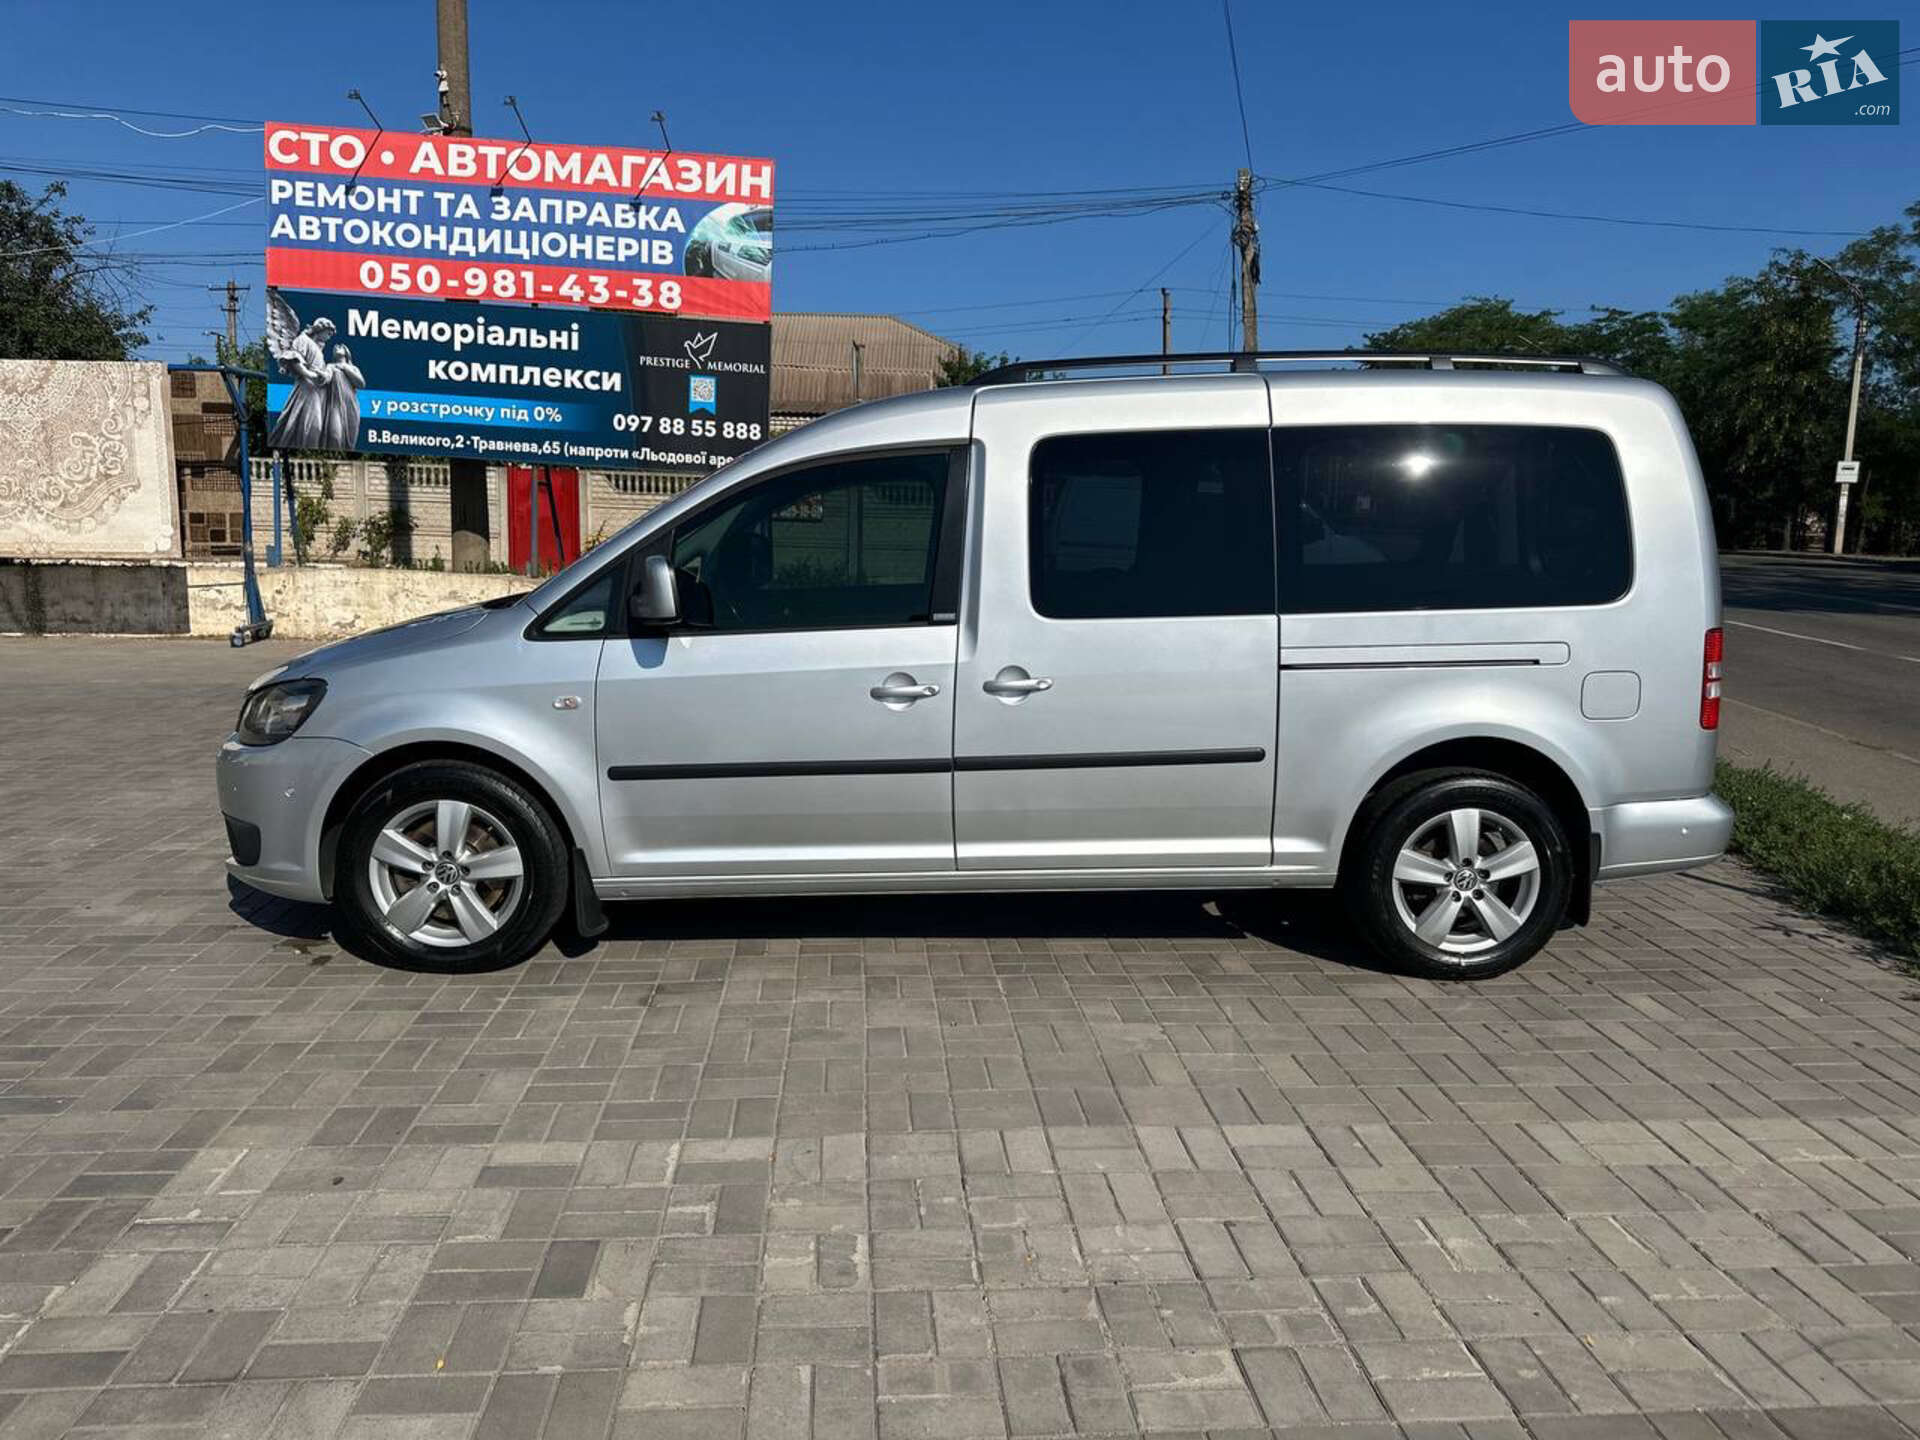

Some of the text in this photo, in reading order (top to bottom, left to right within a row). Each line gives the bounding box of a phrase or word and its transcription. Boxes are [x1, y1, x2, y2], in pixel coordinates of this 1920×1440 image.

[268, 130, 772, 198] СТО АВТОМАГАЗИН
[270, 179, 686, 233] РЕМОНТ ТА ЗАПРАВКА
[270, 214, 674, 265] АВТОКОНДИЦІОНЕРІВ
[359, 260, 682, 310] 050-981-43-38
[348, 309, 580, 351] Меморіальні
[428, 359, 622, 392] комплекси
[640, 356, 766, 374] PRESTIGE MEMORIAL
[371, 400, 562, 422] у розстрочку під 0%
[613, 413, 762, 440] 097 88 55 888
[564, 442, 629, 461] (напроти
[632, 447, 706, 464] «Льодової
